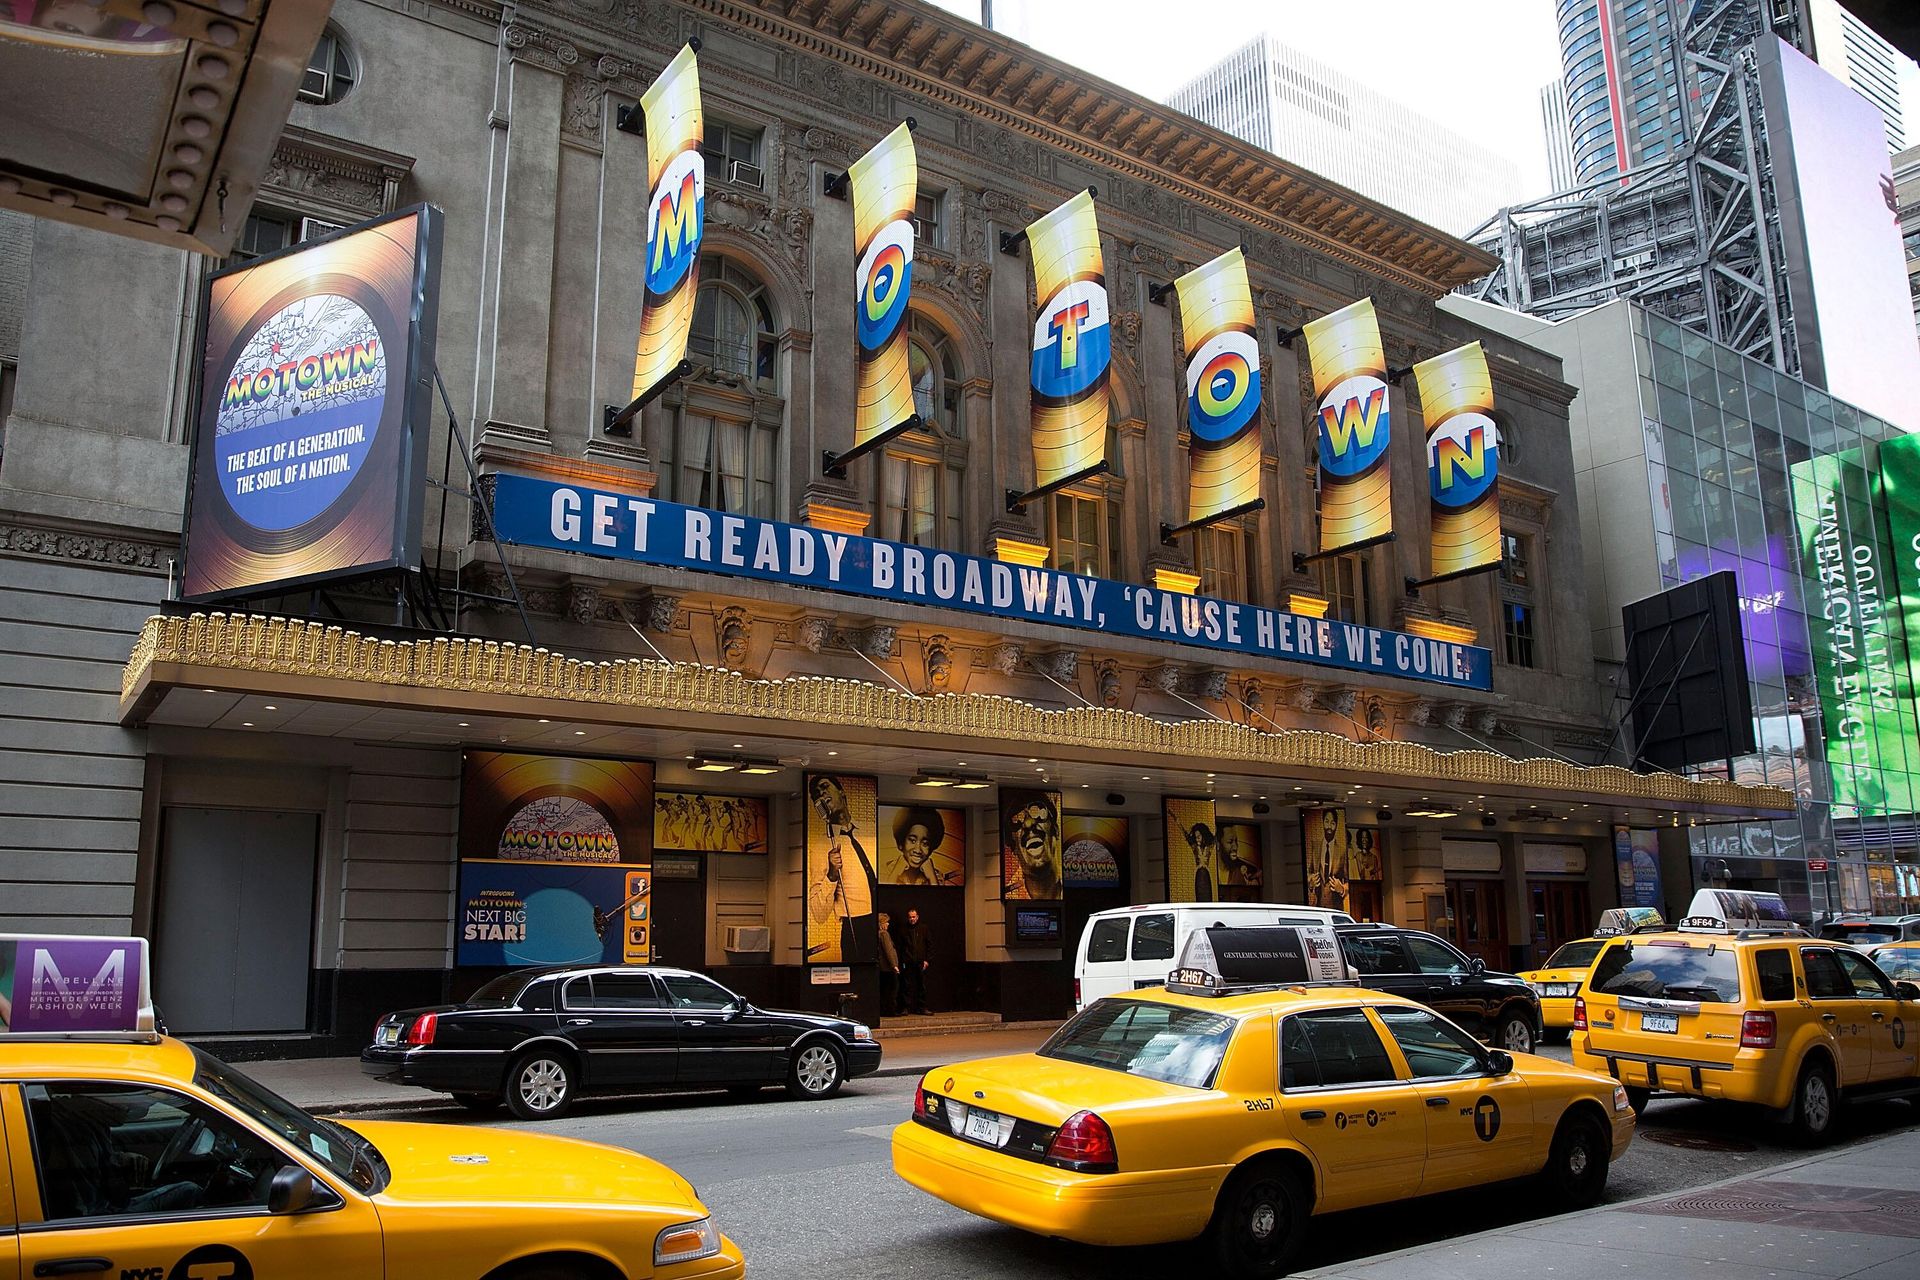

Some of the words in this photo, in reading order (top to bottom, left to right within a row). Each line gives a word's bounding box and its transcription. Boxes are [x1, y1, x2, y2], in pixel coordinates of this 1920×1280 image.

[650, 168, 701, 280] M
[861, 240, 907, 325] O
[1046, 299, 1090, 377] T
[222, 339, 377, 412] MOTOWN
[1195, 350, 1253, 420] O
[301, 387, 322, 402] THE
[325, 375, 375, 397] MUSICAL
[1319, 386, 1386, 459] W
[227, 452, 246, 473] THE
[247, 446, 273, 468] BEAT
[273, 441, 287, 463] OF
[287, 439, 296, 459] A
[297, 424, 366, 457] GENERATION.
[1432, 425, 1486, 493] N
[236, 475, 255, 495] THE
[256, 469, 283, 491] SOUL
[284, 464, 299, 485] OF
[299, 461, 307, 481] A
[308, 453, 351, 475] NATION.
[550, 487, 656, 553] GET
[684, 508, 849, 582] READY
[871, 541, 1105, 628] BROADWAY,
[1124, 585, 1242, 644] 'CAUSE
[1256, 609, 1333, 658] HERE
[1343, 625, 1384, 666] WE
[1395, 632, 1472, 681] COME.
[502, 828, 615, 851] MOTOWN
[579, 851, 614, 859] MUSICAL
[466, 910, 501, 923] NEXT
[504, 910, 527, 923] BIG
[1691, 918, 1713, 927] 9F64
[464, 924, 527, 941] STAR!
[1223, 951, 1260, 960] GENTLEMEN,
[1260, 951, 1273, 959] THIS
[1273, 951, 1279, 959] IS
[1279, 951, 1299, 959] VODKA.
[32, 977, 124, 985] MAYBELLINE
[1180, 969, 1204, 985] 2H67
[29, 1003, 84, 1011] FASHION
[1460, 1107, 1474, 1117] NYC
[120, 1266, 164, 1280] NYC
